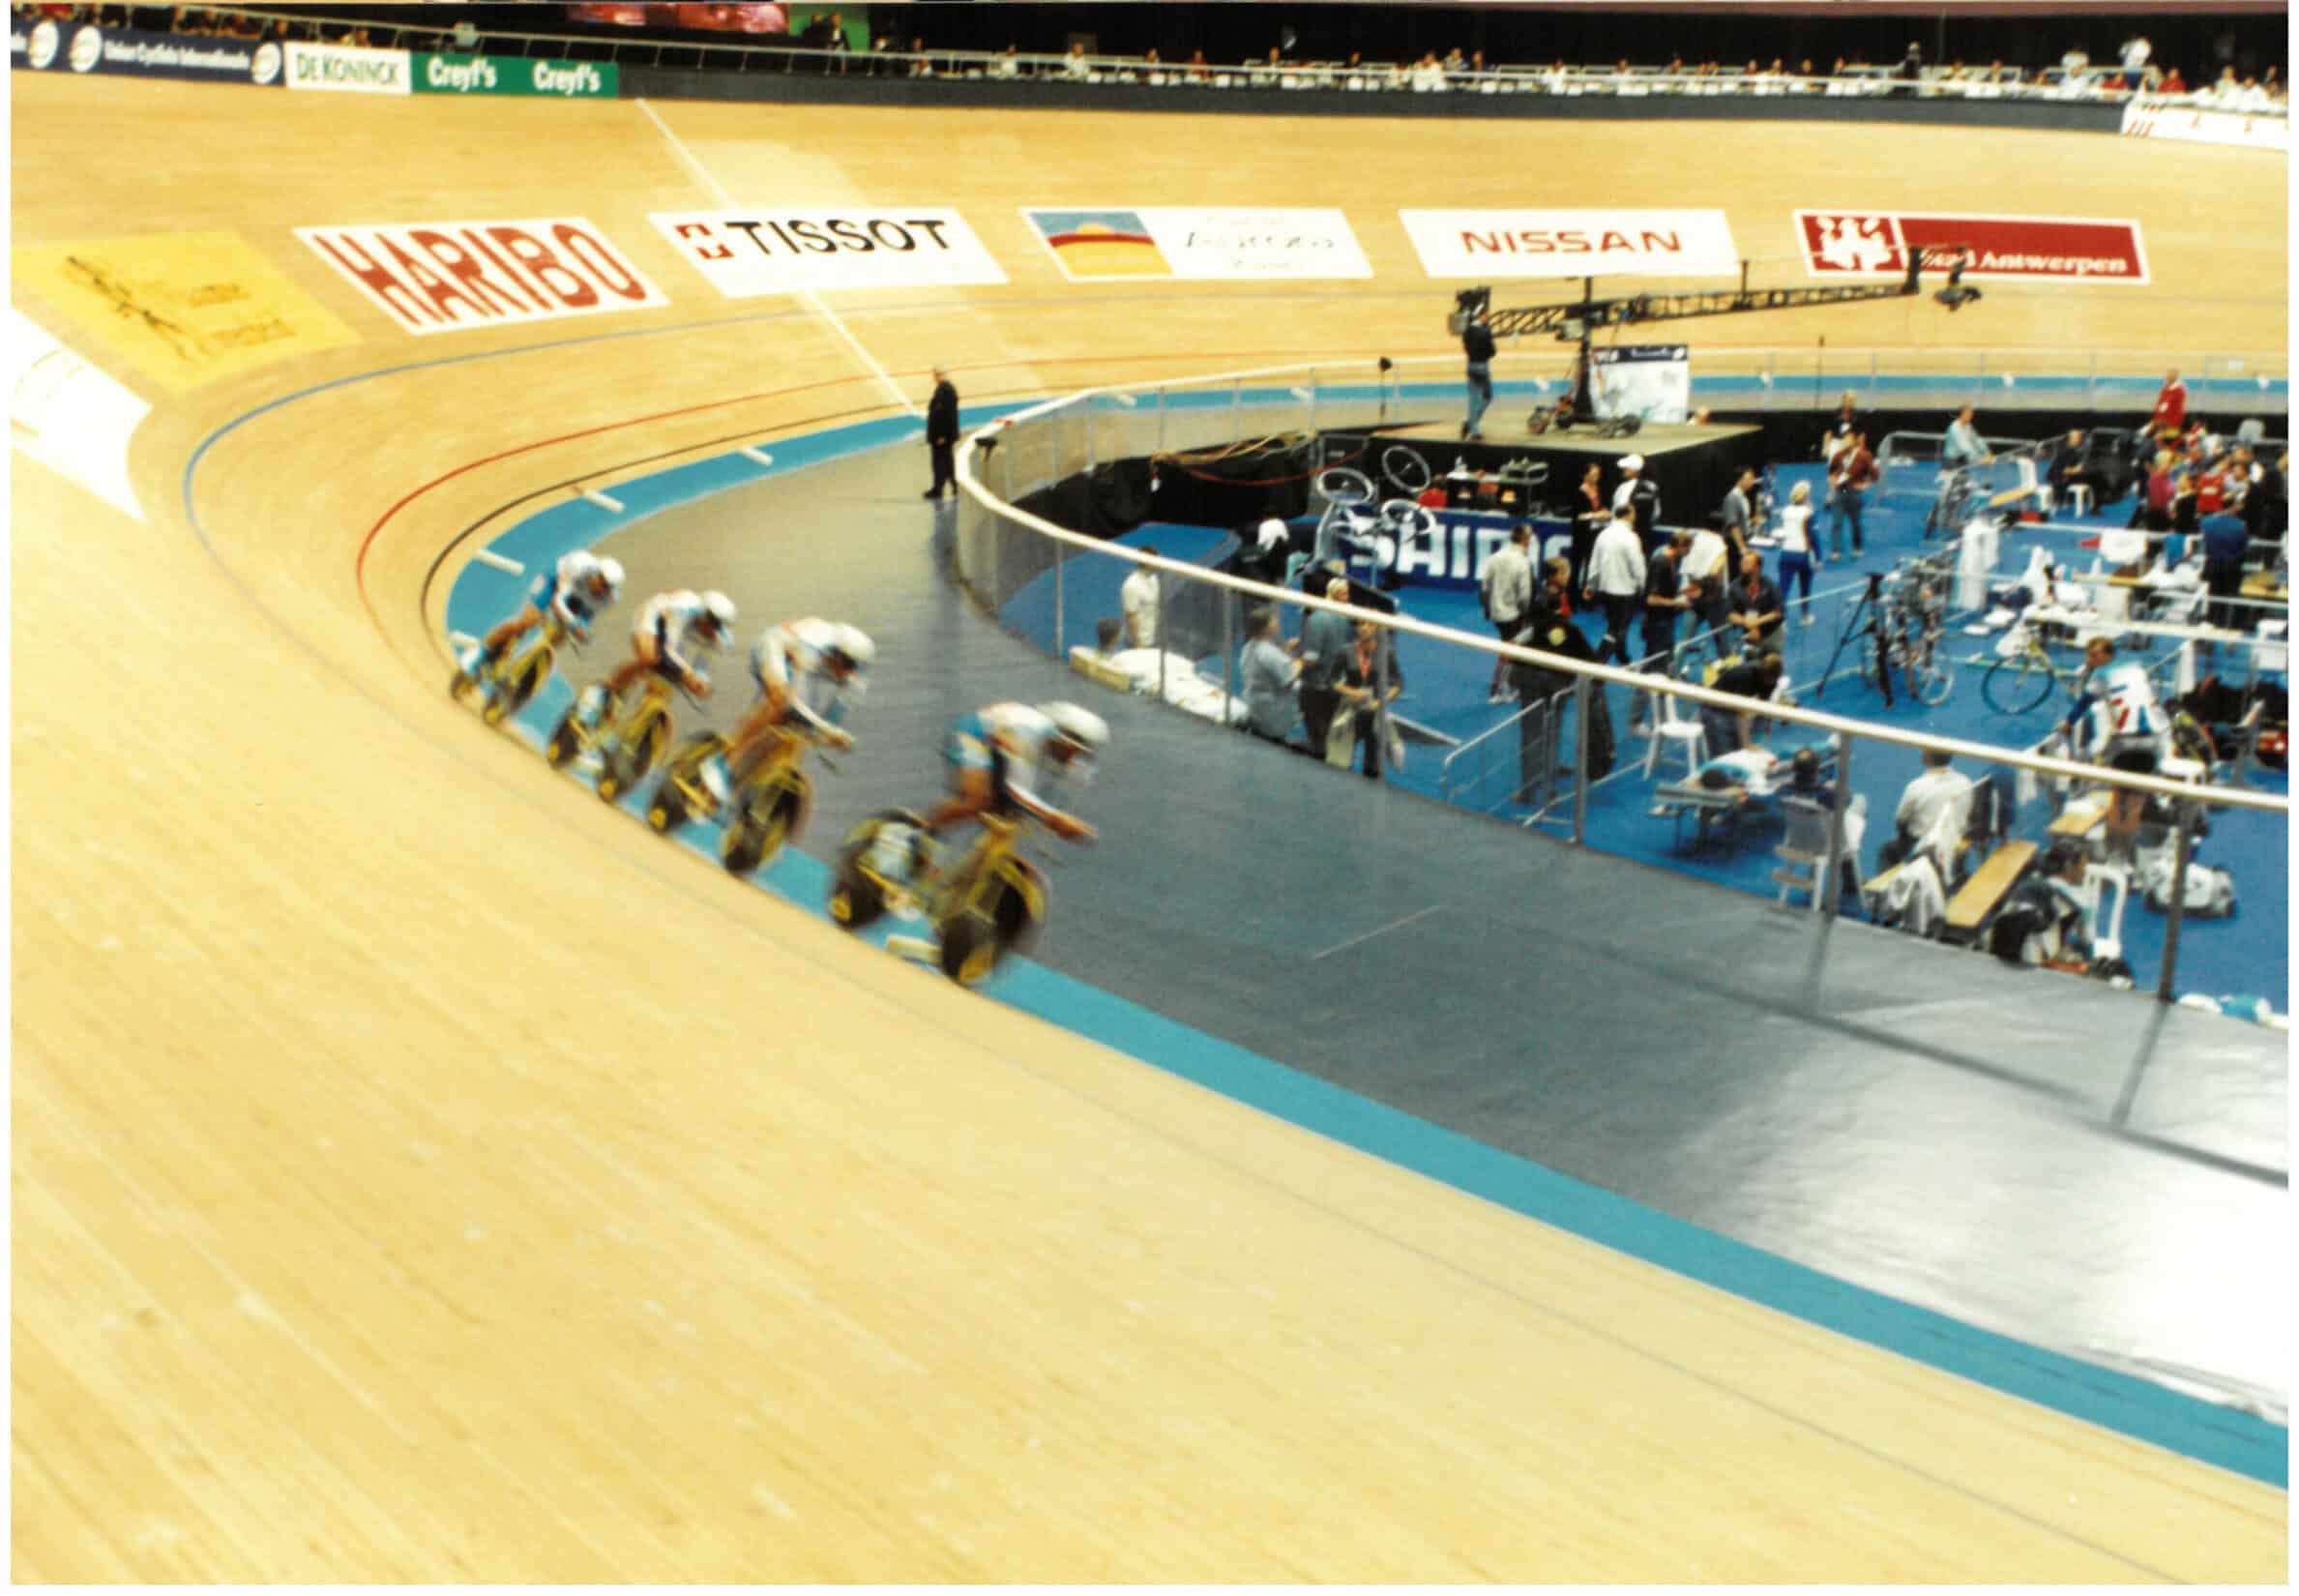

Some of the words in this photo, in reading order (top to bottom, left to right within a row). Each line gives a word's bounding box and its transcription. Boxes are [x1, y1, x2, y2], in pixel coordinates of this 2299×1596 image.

[295, 52, 315, 79] DE
[317, 52, 399, 84] KONINCK
[724, 220, 950, 255] TISSOT
[1459, 230, 1682, 253] NISSAN
[312, 223, 647, 325] HARIBO
[1980, 251, 2128, 276] Antwerpen
